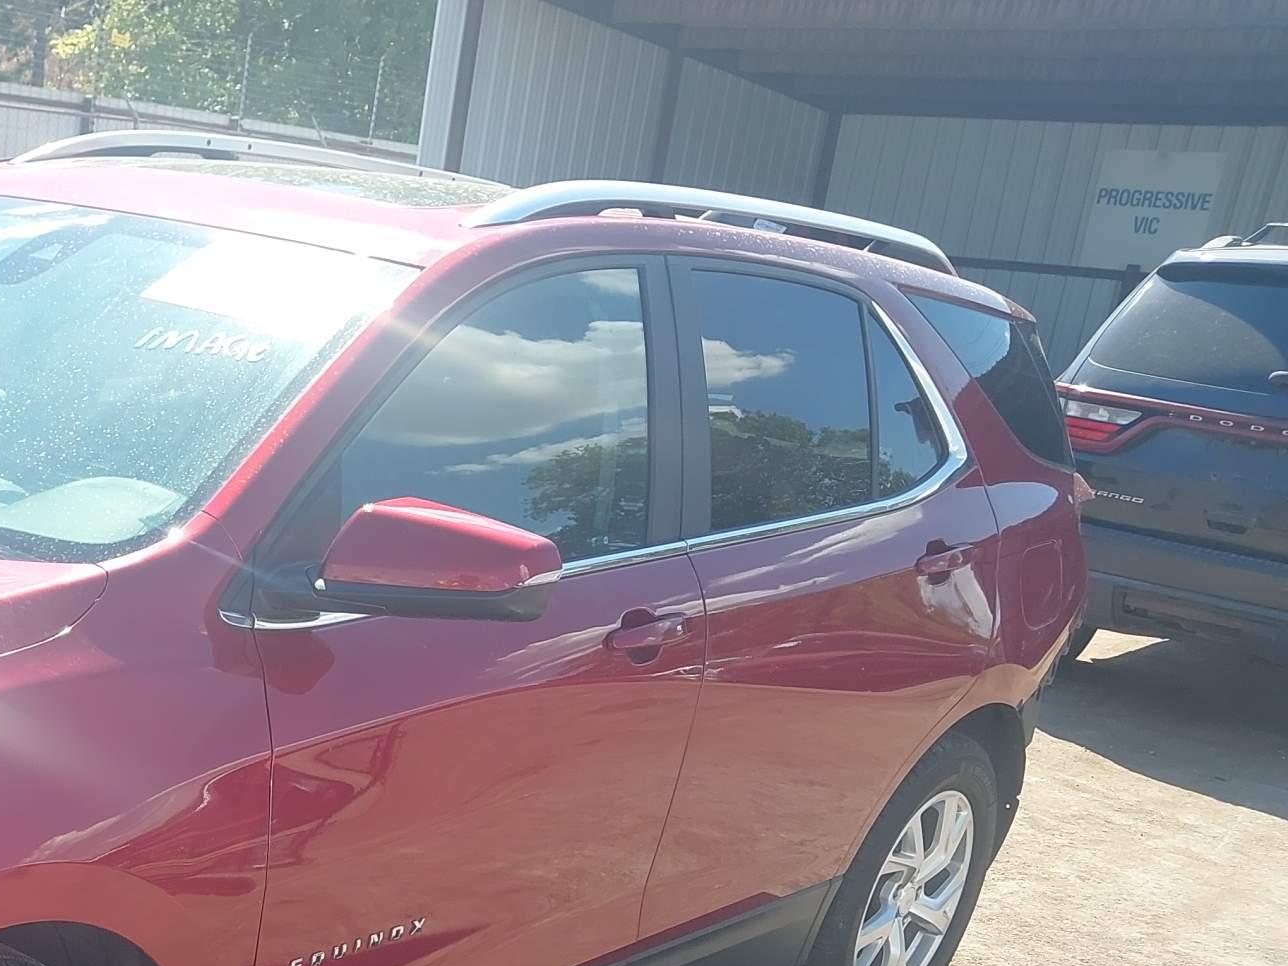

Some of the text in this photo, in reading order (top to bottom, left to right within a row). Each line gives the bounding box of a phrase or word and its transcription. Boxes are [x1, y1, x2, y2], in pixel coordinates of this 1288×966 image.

[1096, 187, 1213, 211] PROGRESSIVE
[1133, 216, 1161, 234] VIC
[1096, 490, 1145, 504] ANGO
